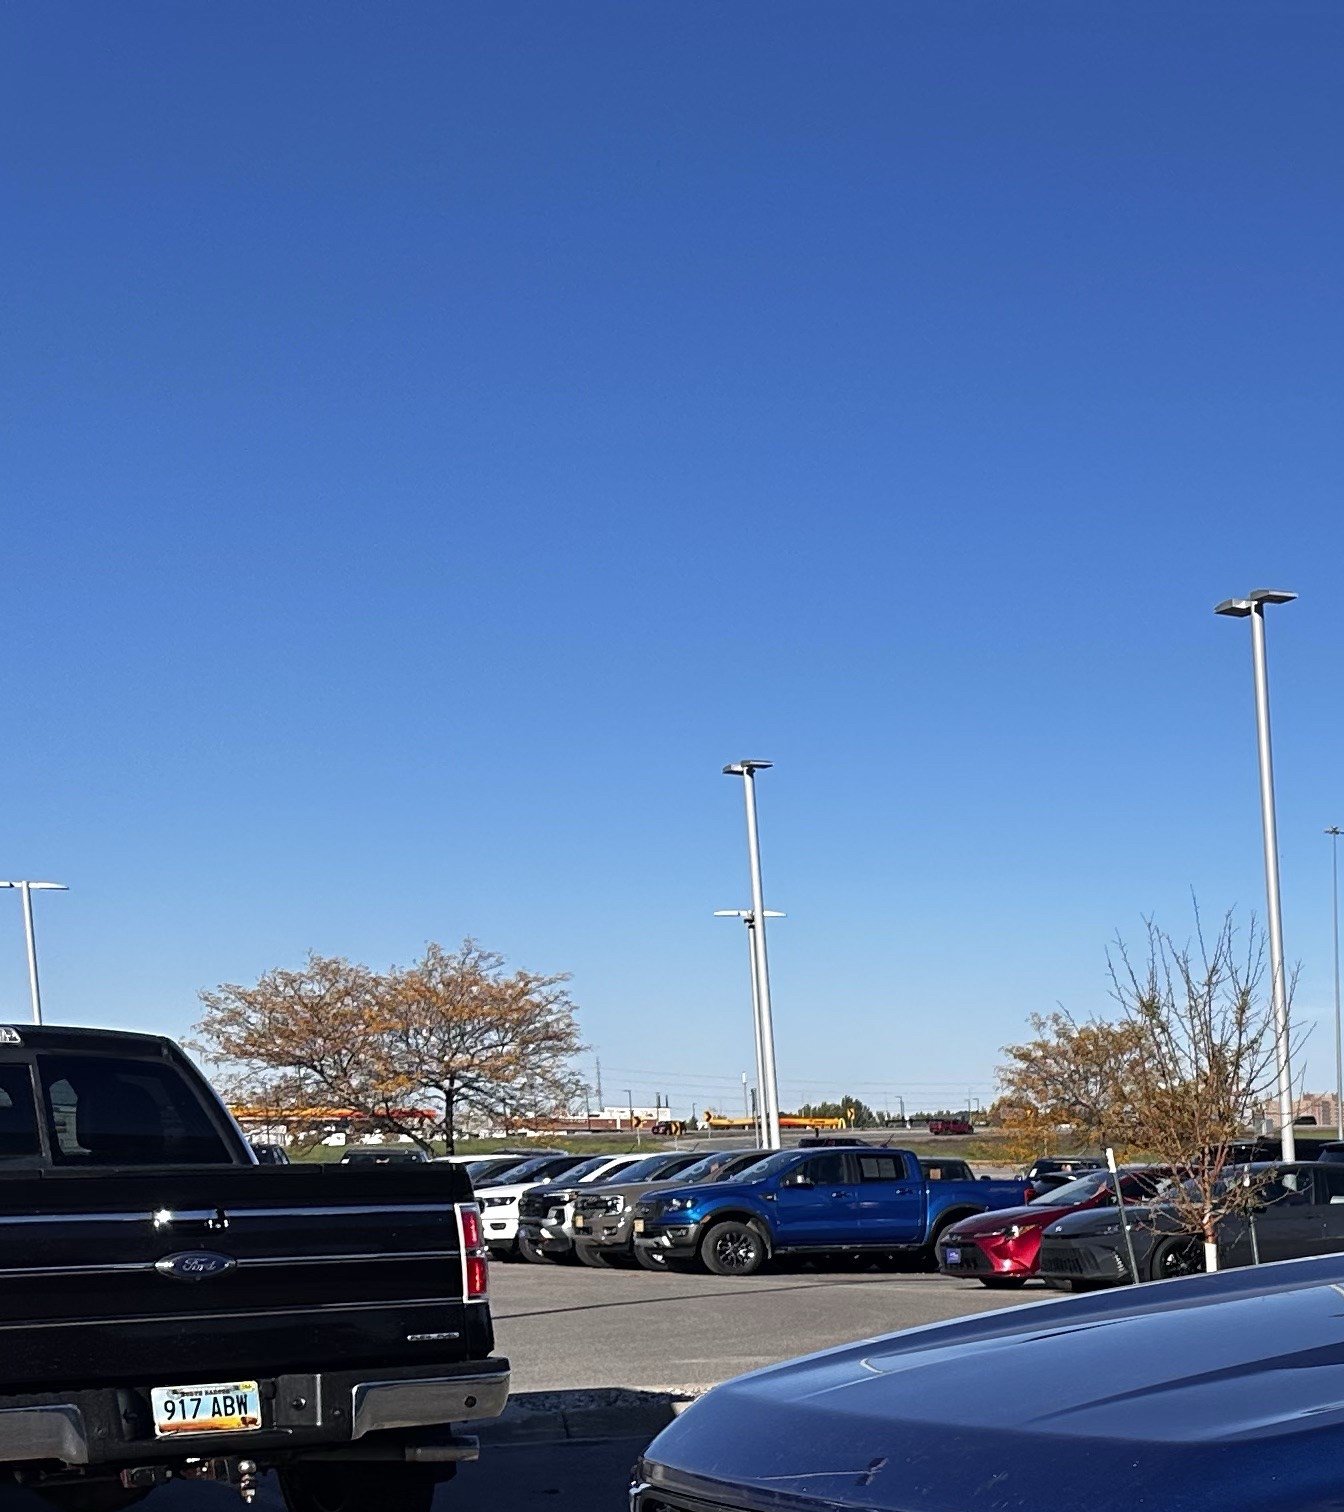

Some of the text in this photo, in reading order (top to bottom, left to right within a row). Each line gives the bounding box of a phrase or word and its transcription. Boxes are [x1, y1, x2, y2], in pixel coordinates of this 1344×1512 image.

[183, 1258, 216, 1271] Ford
[164, 1394, 248, 1420] 917 ABW
